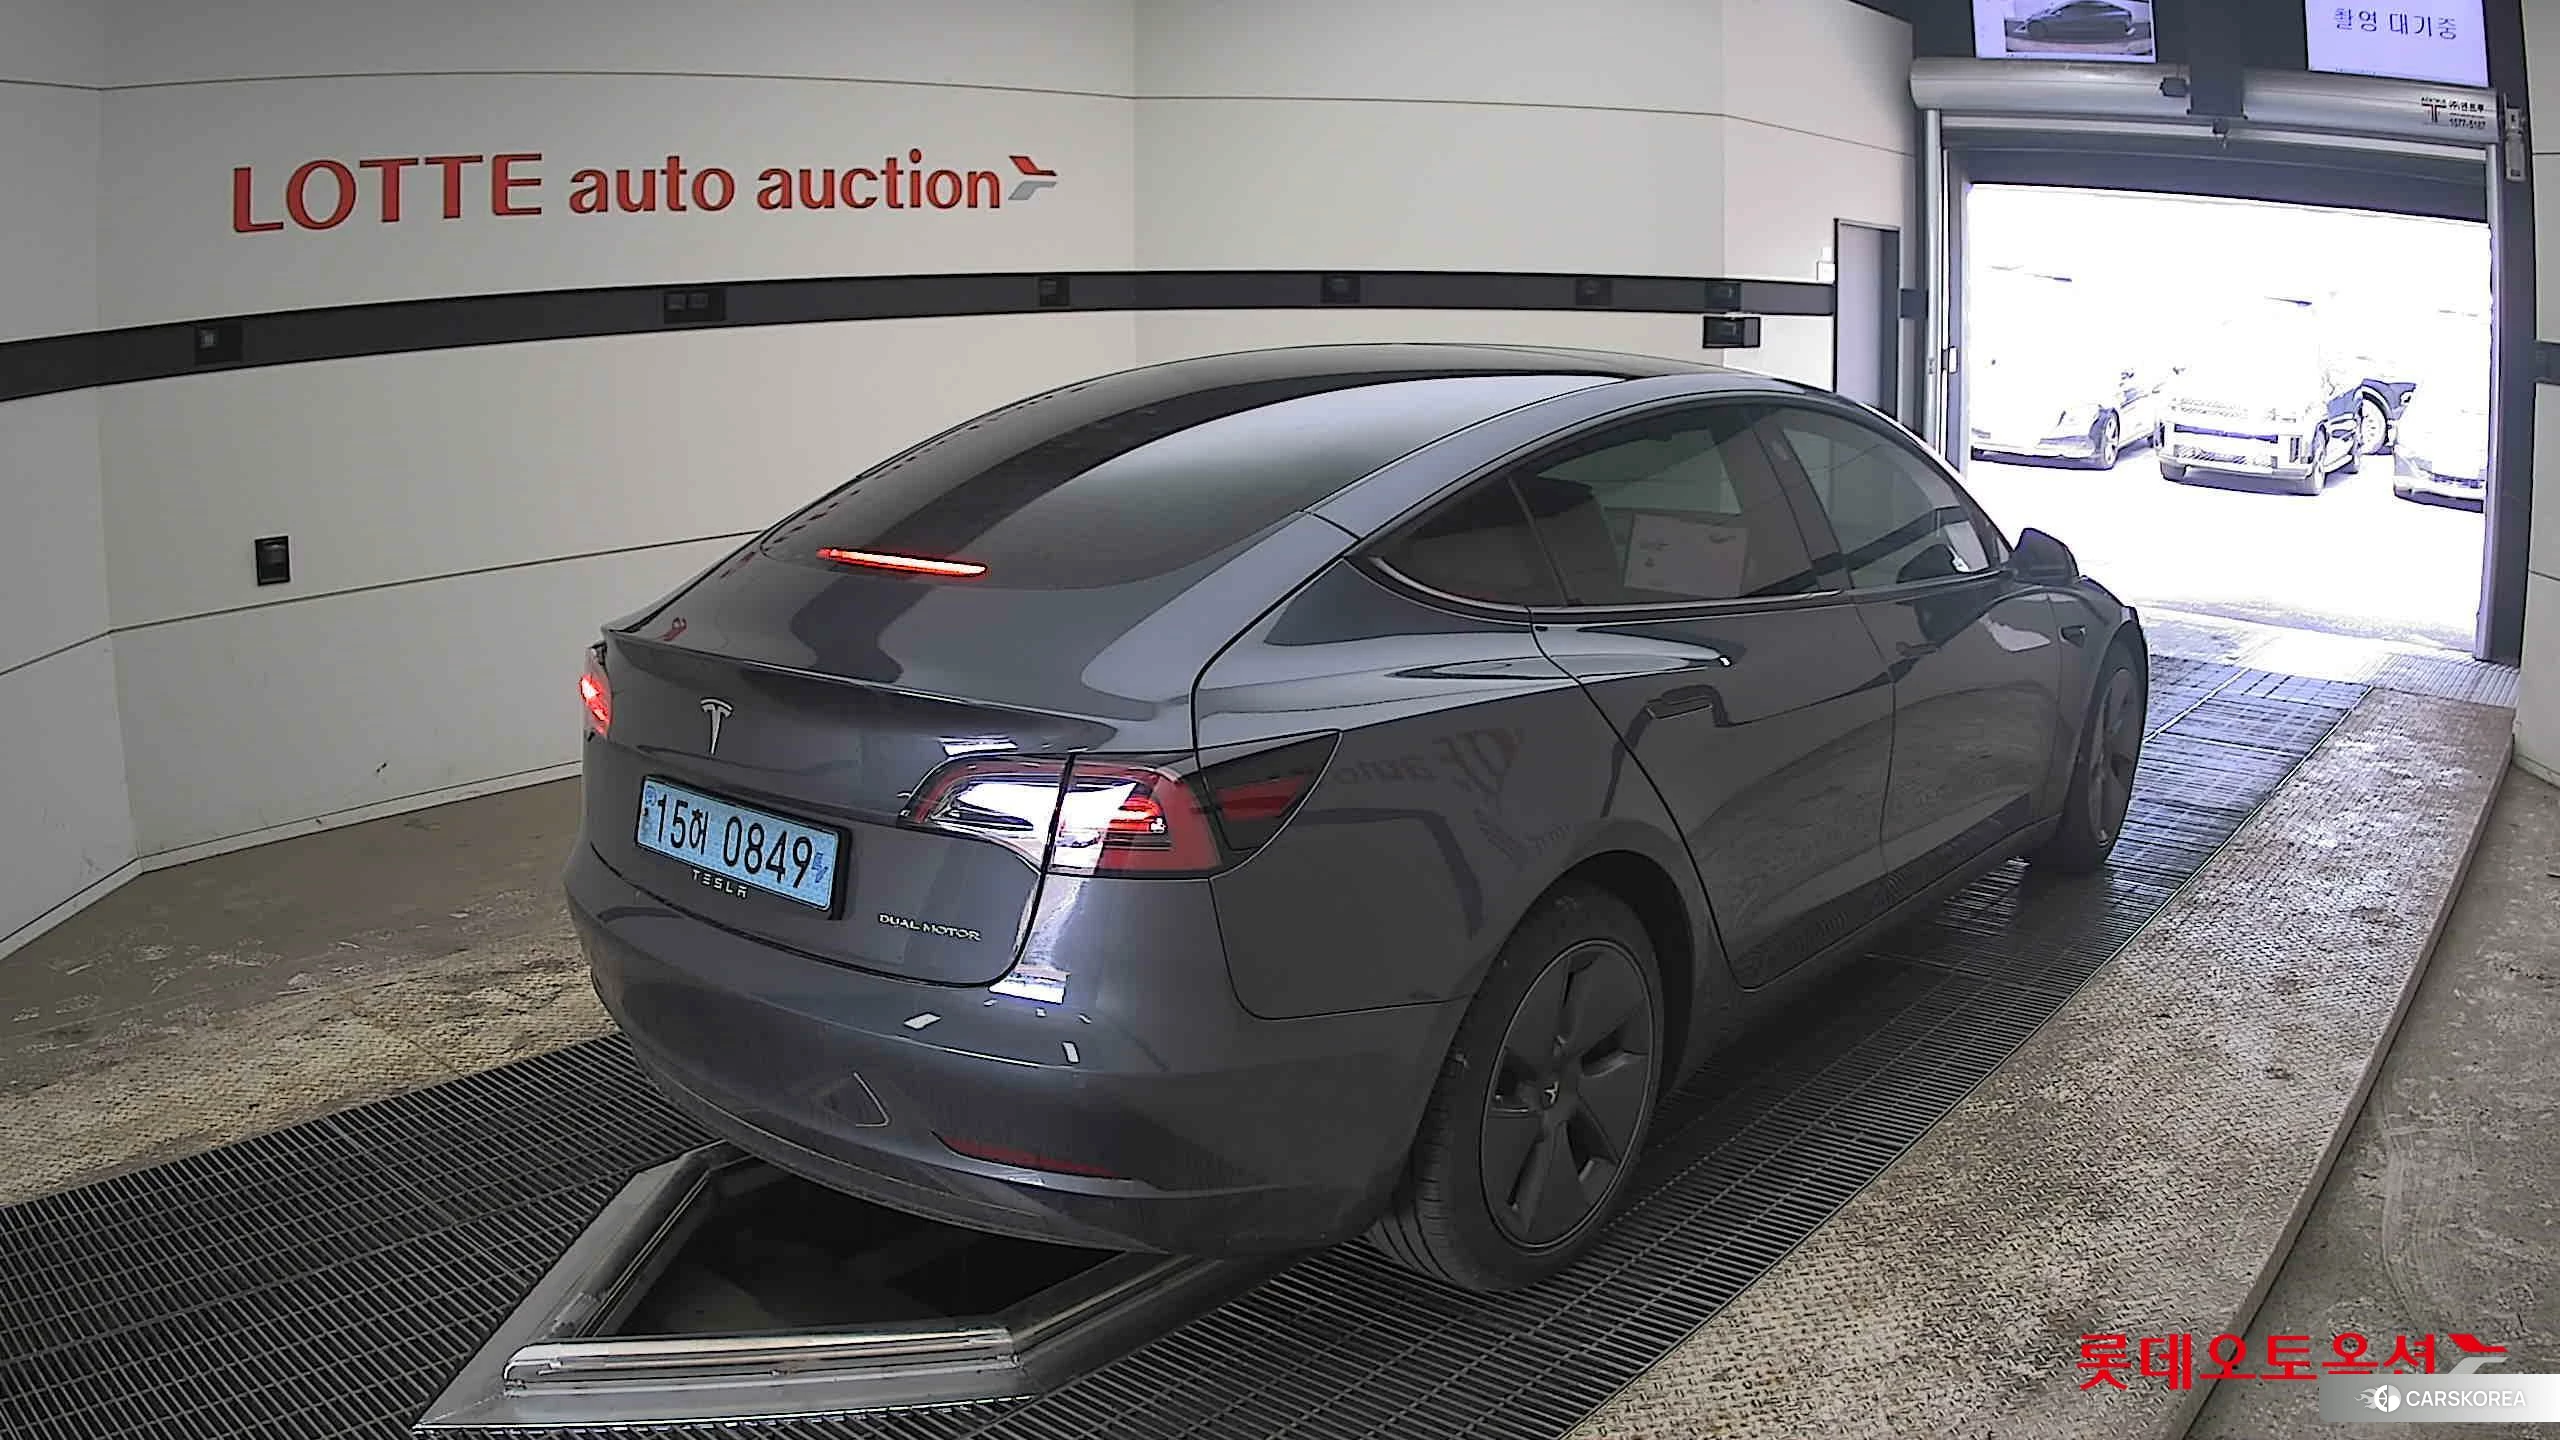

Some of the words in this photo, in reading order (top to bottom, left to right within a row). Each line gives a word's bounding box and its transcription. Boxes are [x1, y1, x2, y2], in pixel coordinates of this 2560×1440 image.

[2334, 8, 2378, 32] 촬영
[2389, 13, 2457, 40] 대기중
[233, 153, 543, 233] LOTTE
[568, 155, 735, 214] auto
[757, 148, 1001, 210] auction
[657, 794, 710, 855] 15허
[723, 815, 813, 889] 0849
[691, 868, 749, 899] TESLA
[879, 914, 921, 930] DUAL
[922, 922, 982, 941] MOTOR
